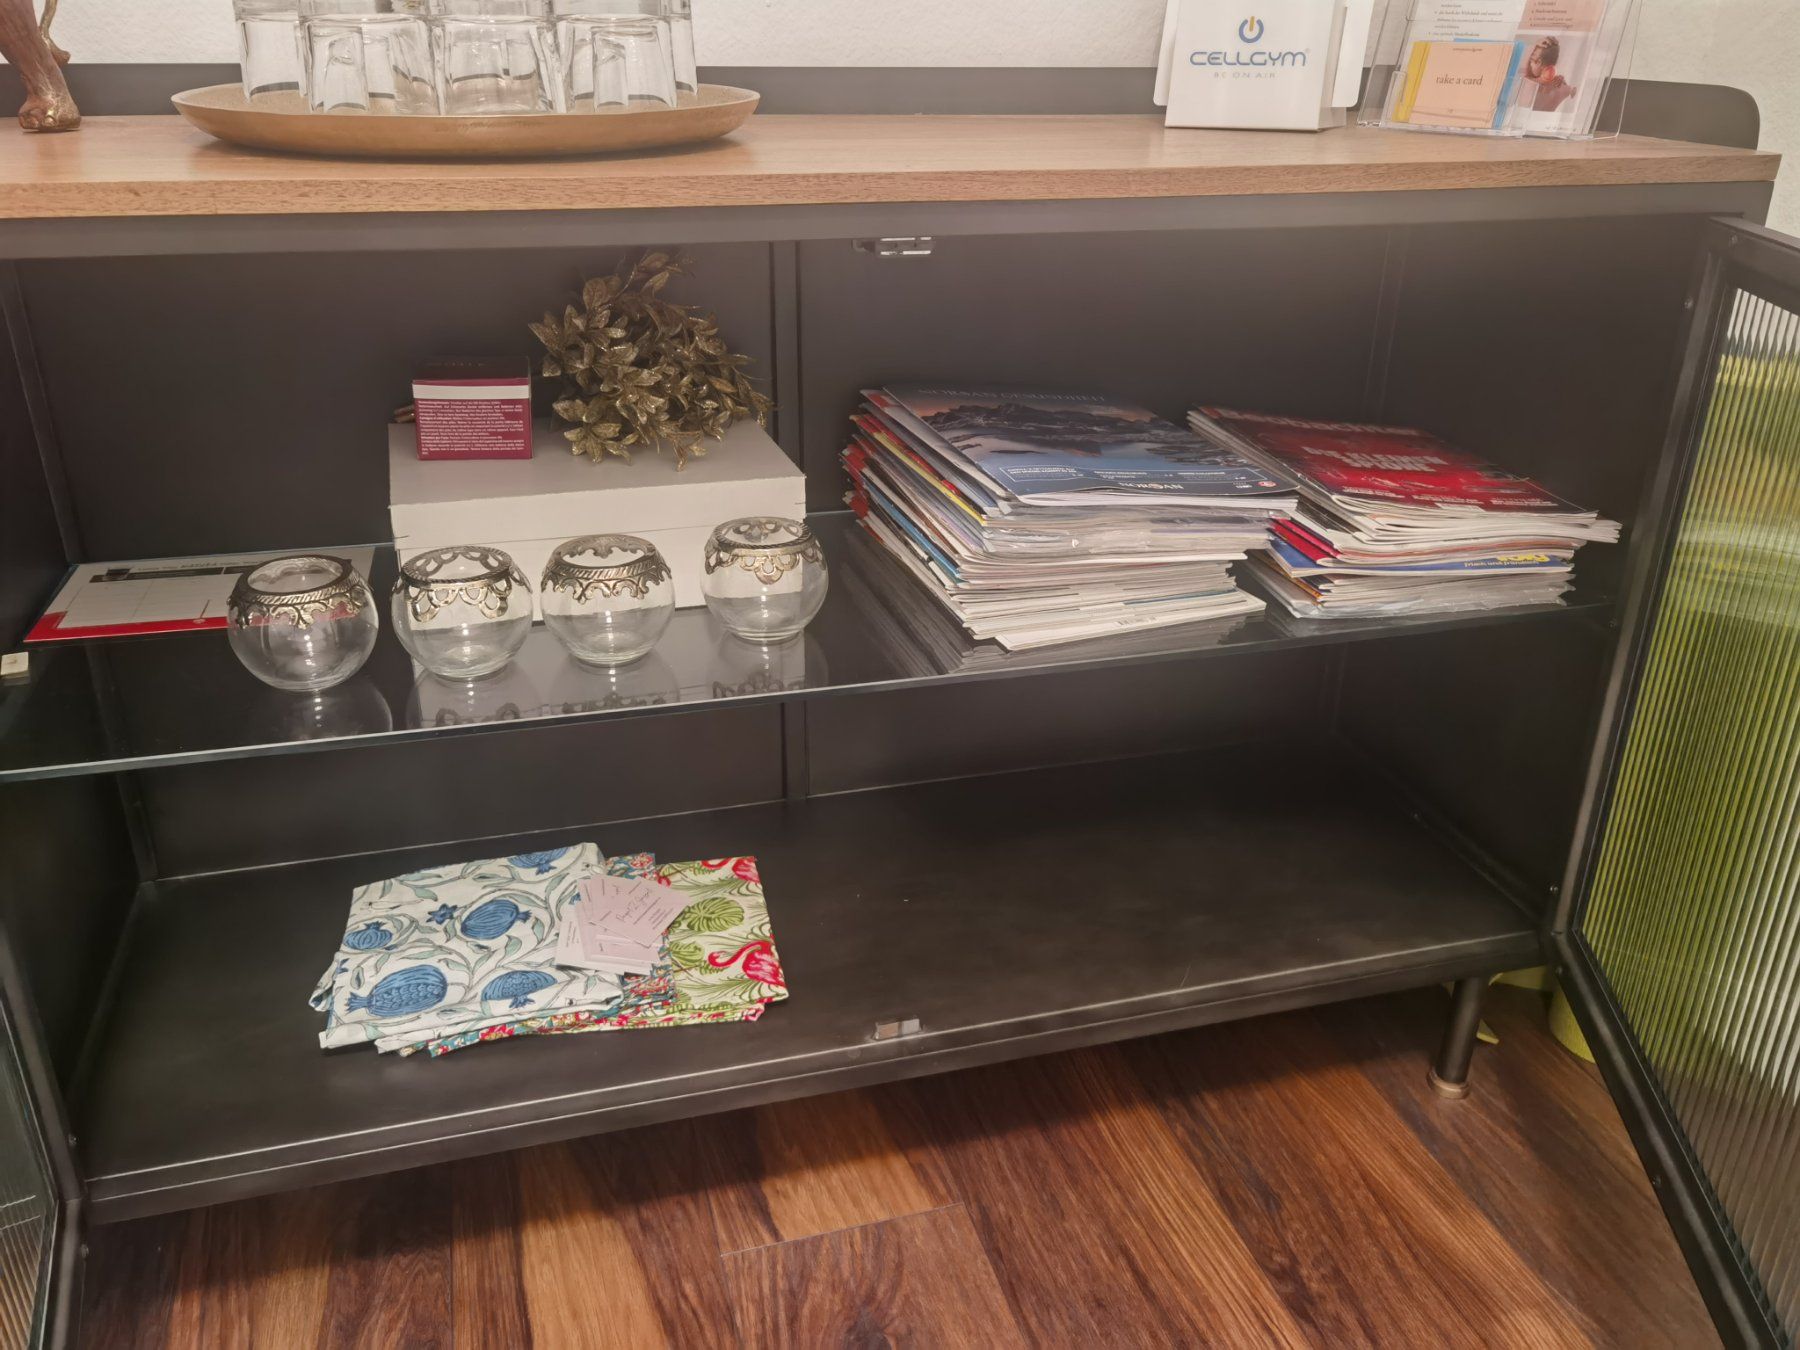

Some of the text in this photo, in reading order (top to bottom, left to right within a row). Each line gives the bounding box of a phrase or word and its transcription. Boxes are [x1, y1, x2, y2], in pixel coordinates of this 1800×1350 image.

[1189, 51, 1306, 66] CELLGYM
[1232, 71, 1250, 79] ON
[1255, 71, 1276, 79] AIR
[1436, 74, 1455, 85] take
[1462, 74, 1484, 86] card
